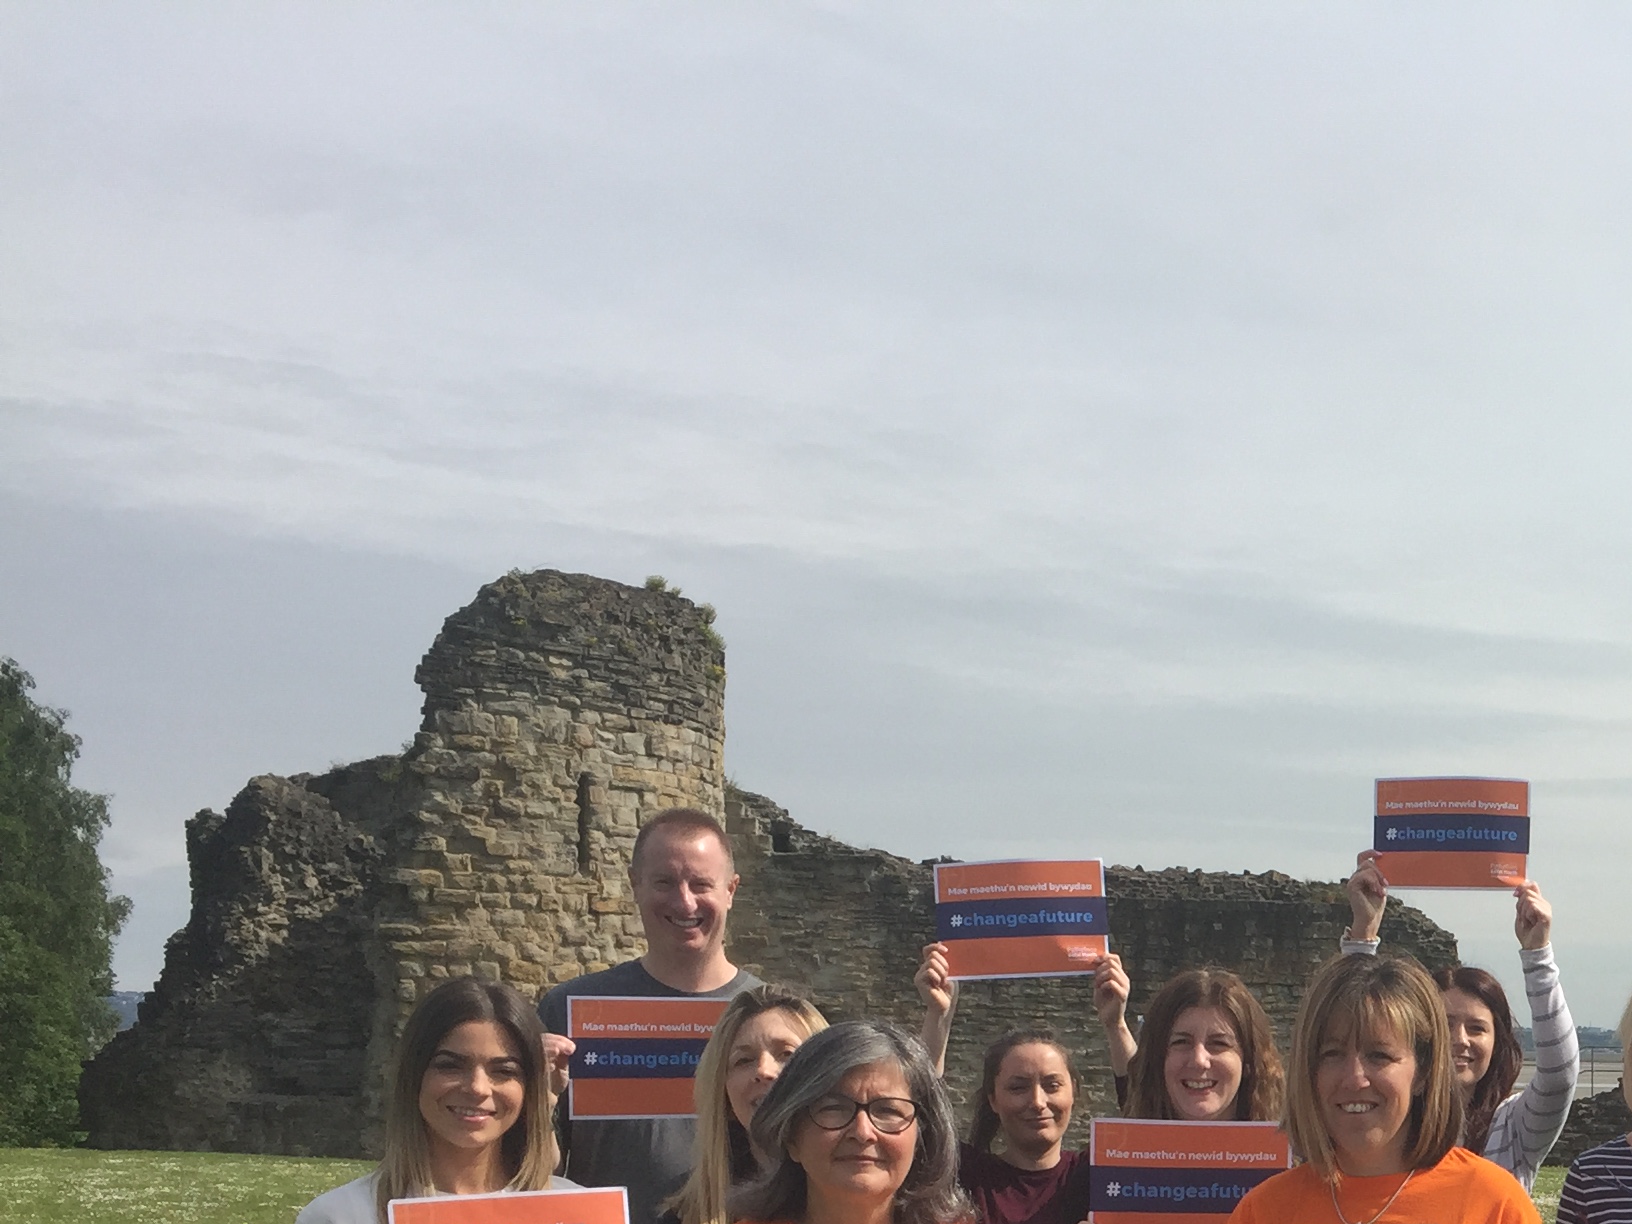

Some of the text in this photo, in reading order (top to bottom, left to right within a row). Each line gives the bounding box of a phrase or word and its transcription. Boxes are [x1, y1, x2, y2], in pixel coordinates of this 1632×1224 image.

[1385, 801, 1403, 809] Mae
[1386, 826, 1518, 842] #changeafuture
[948, 888, 968, 896] Mae
[1018, 883, 1047, 892] newid
[950, 909, 1093, 928] #changeafuture
[582, 1022, 605, 1031] Mae
[584, 1051, 700, 1069] #changeafu
[1105, 1149, 1277, 1163] Mae maethu'n newid bywydau
